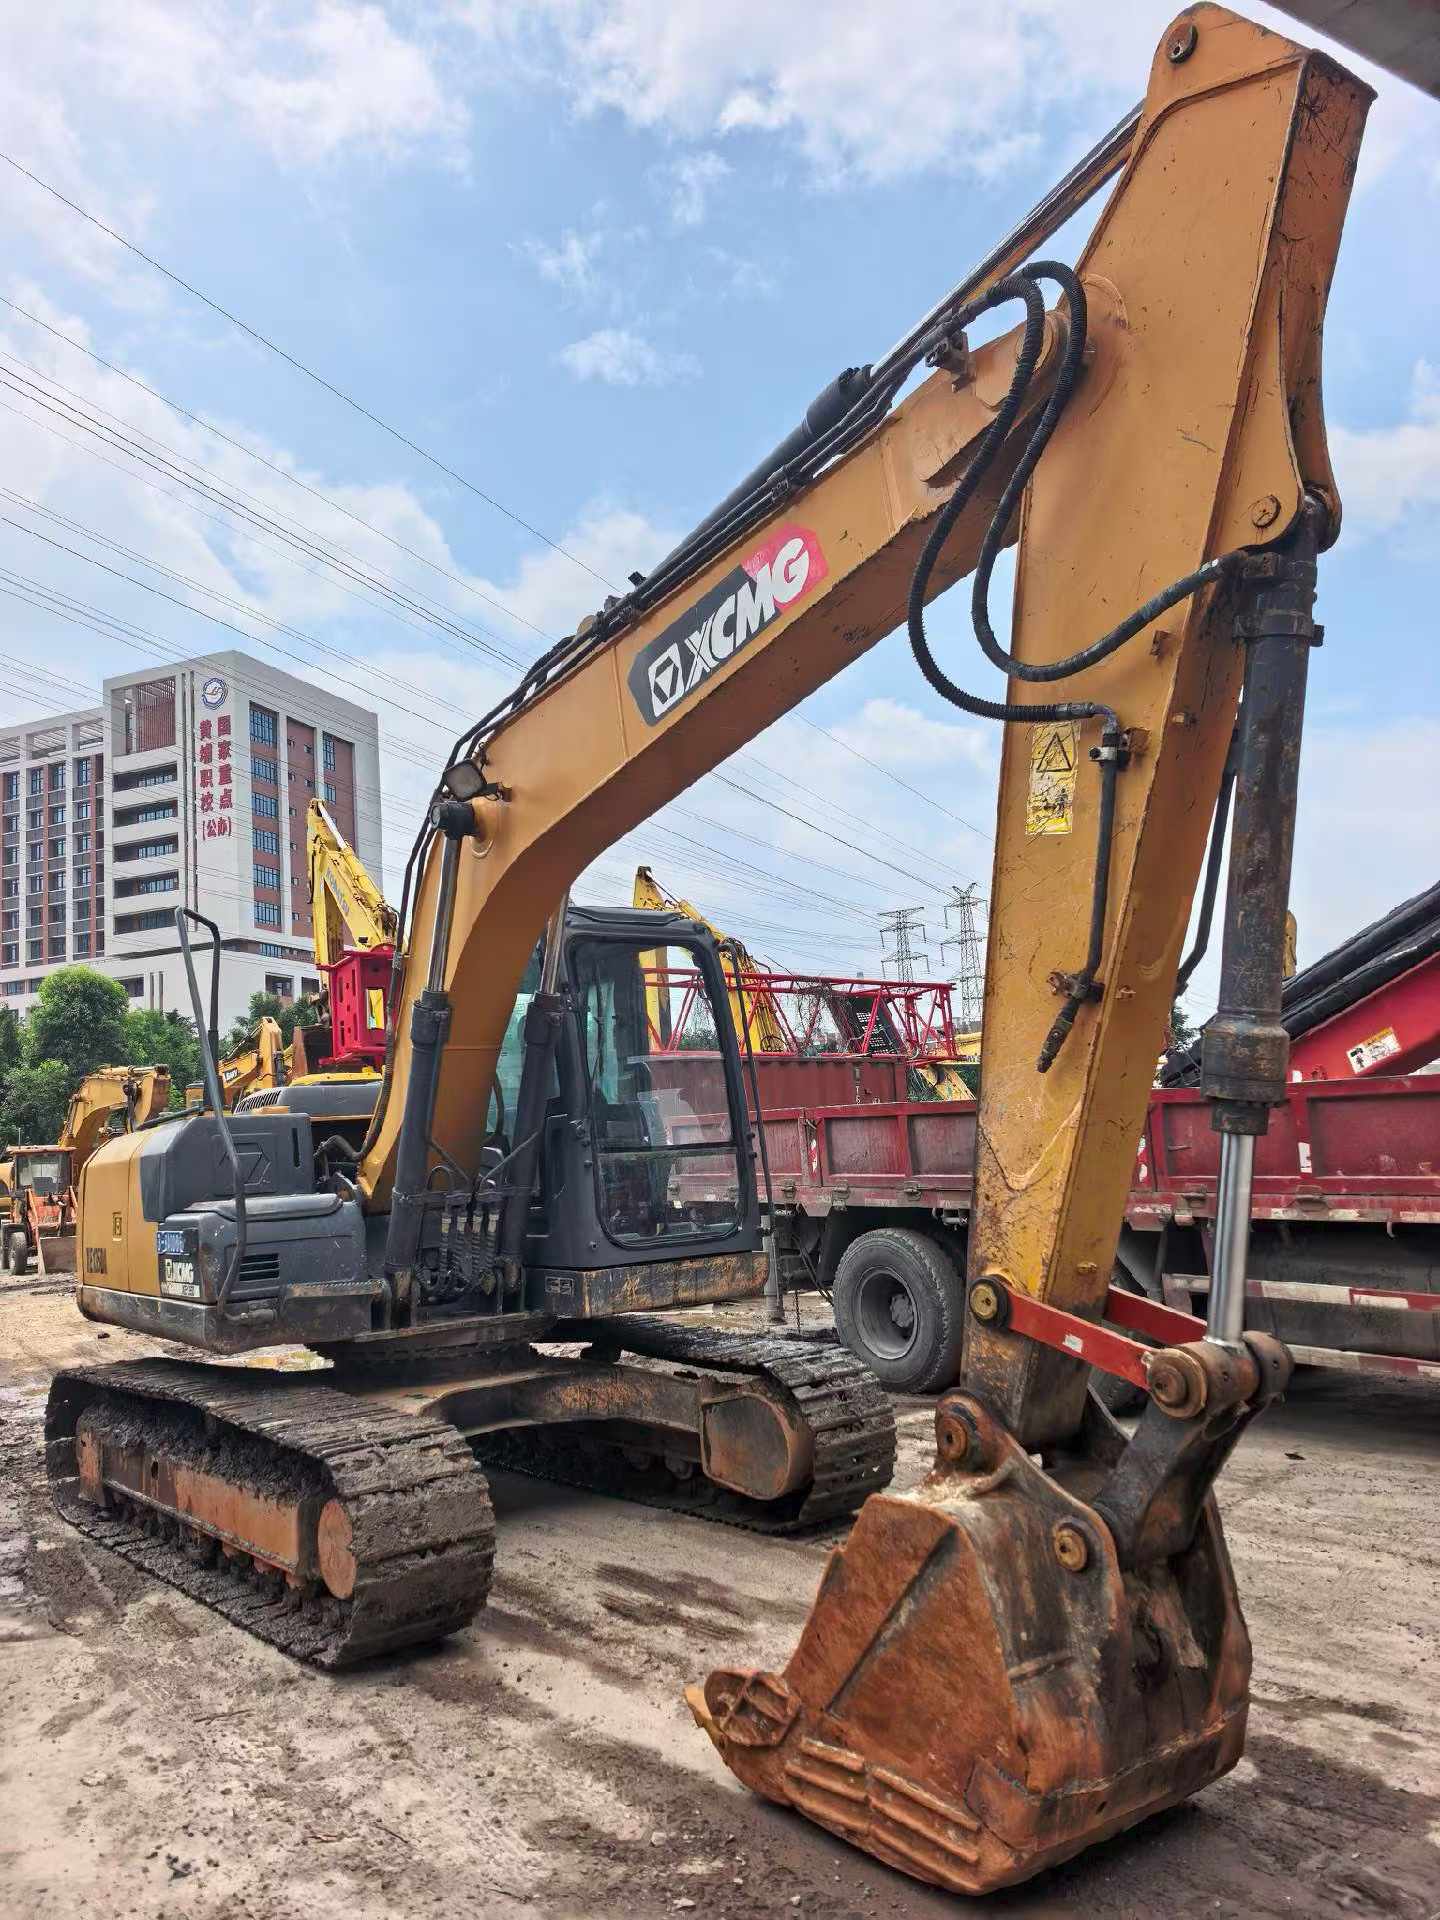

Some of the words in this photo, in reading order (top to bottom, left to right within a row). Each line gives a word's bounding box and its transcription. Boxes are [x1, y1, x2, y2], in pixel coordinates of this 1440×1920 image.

[685, 537, 810, 692] XCMG
[217, 714, 233, 810] 国家重点
